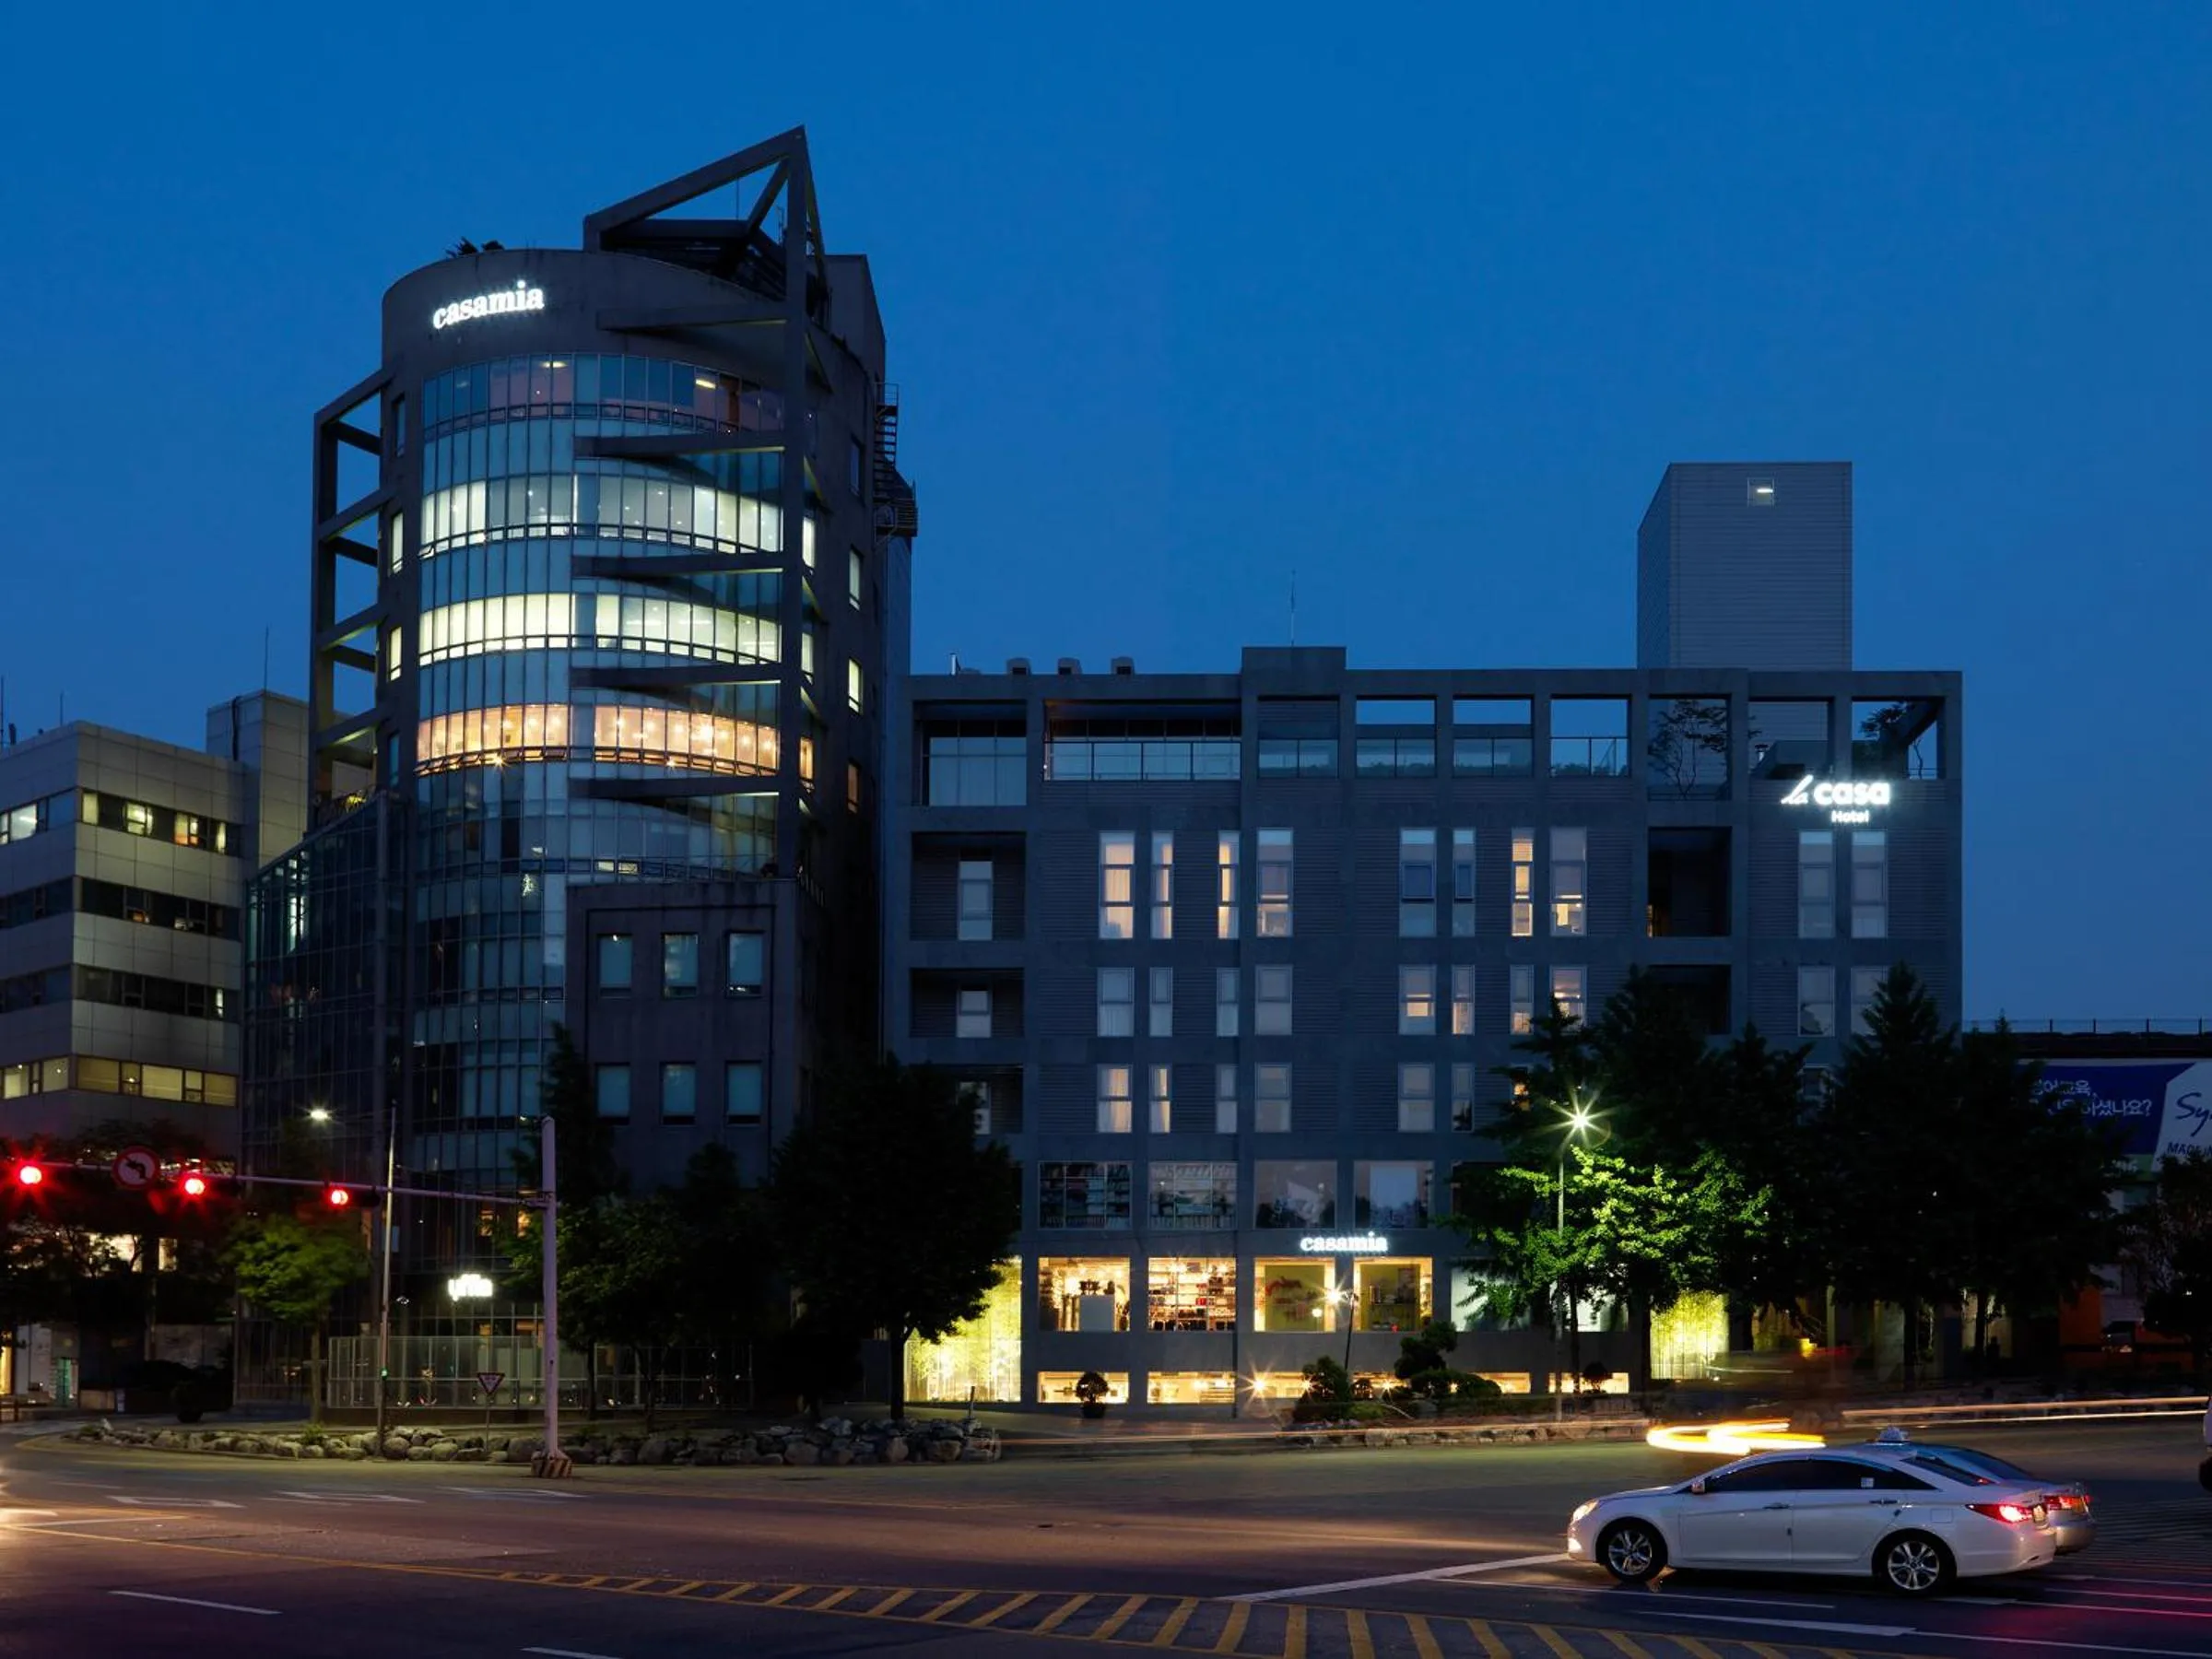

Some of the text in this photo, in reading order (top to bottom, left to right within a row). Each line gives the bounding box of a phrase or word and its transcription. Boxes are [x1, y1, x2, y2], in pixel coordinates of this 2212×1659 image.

[432, 279, 546, 329] casamia
[1814, 782, 1890, 806] casa
[2175, 1092, 2212, 1137] Sy
[1300, 1230, 1389, 1252] casamia
